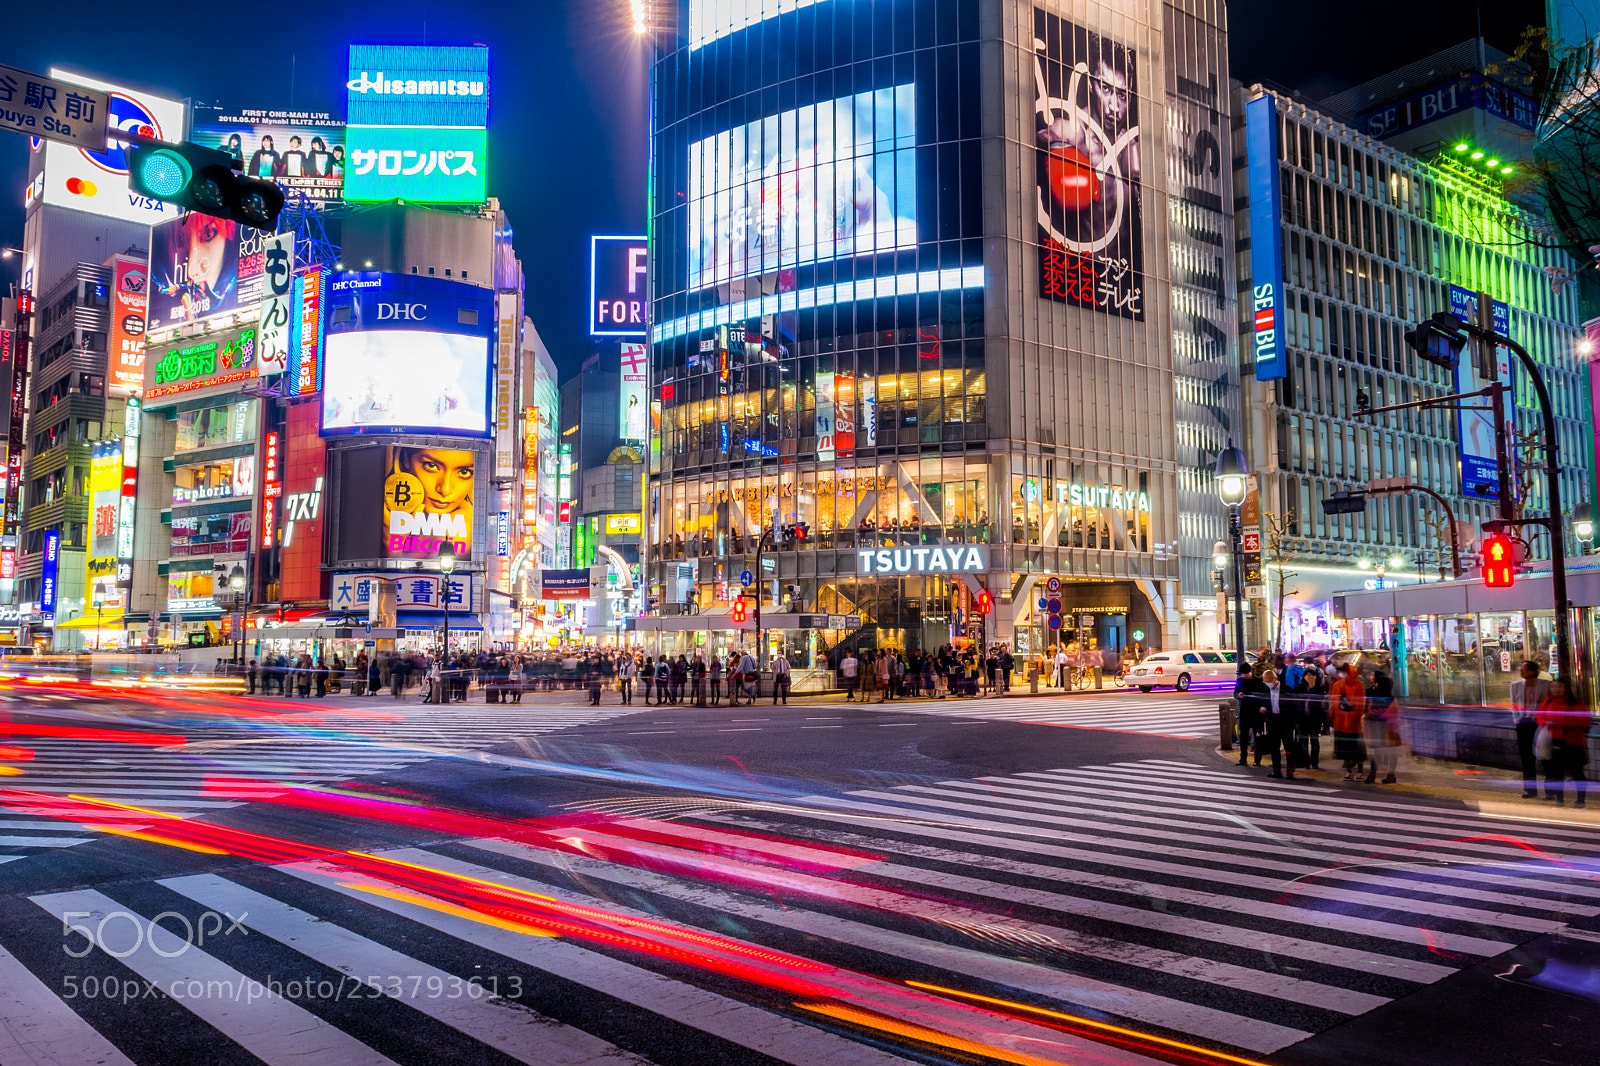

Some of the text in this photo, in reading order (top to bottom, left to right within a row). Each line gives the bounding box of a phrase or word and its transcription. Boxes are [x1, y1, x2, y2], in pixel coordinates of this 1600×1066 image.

[43, 116, 77, 138] Sta.
[268, 110, 308, 119] ONE-MAN
[290, 118, 313, 126] BLITZ
[351, 149, 477, 176] サロンパス
[316, 179, 343, 187] STRIKES
[128, 194, 164, 213] VISA
[173, 246, 210, 284] hide
[1098, 255, 1128, 281] フジ
[332, 279, 381, 290] DHC Channel
[1098, 281, 1141, 314] テレビ
[1452, 290, 1462, 304] FLY
[261, 239, 291, 370] もんじゃ
[376, 303, 427, 321] DHC
[599, 300, 647, 323] FOR
[300, 277, 314, 387] 三千里薬品
[1253, 283, 1276, 363] SEIBU
[2, 330, 11, 362] TOKYO
[180, 351, 216, 378] 西村
[499, 313, 514, 431] Taisei neon
[176, 483, 231, 501] Euphoria
[1056, 483, 1151, 512] TSUTAYA
[95, 503, 117, 537] 薬
[390, 510, 467, 537] DMM
[48, 535, 57, 561] MIZUHO
[859, 548, 984, 572] TSUTAYA
[338, 579, 464, 604] 大盛書店
